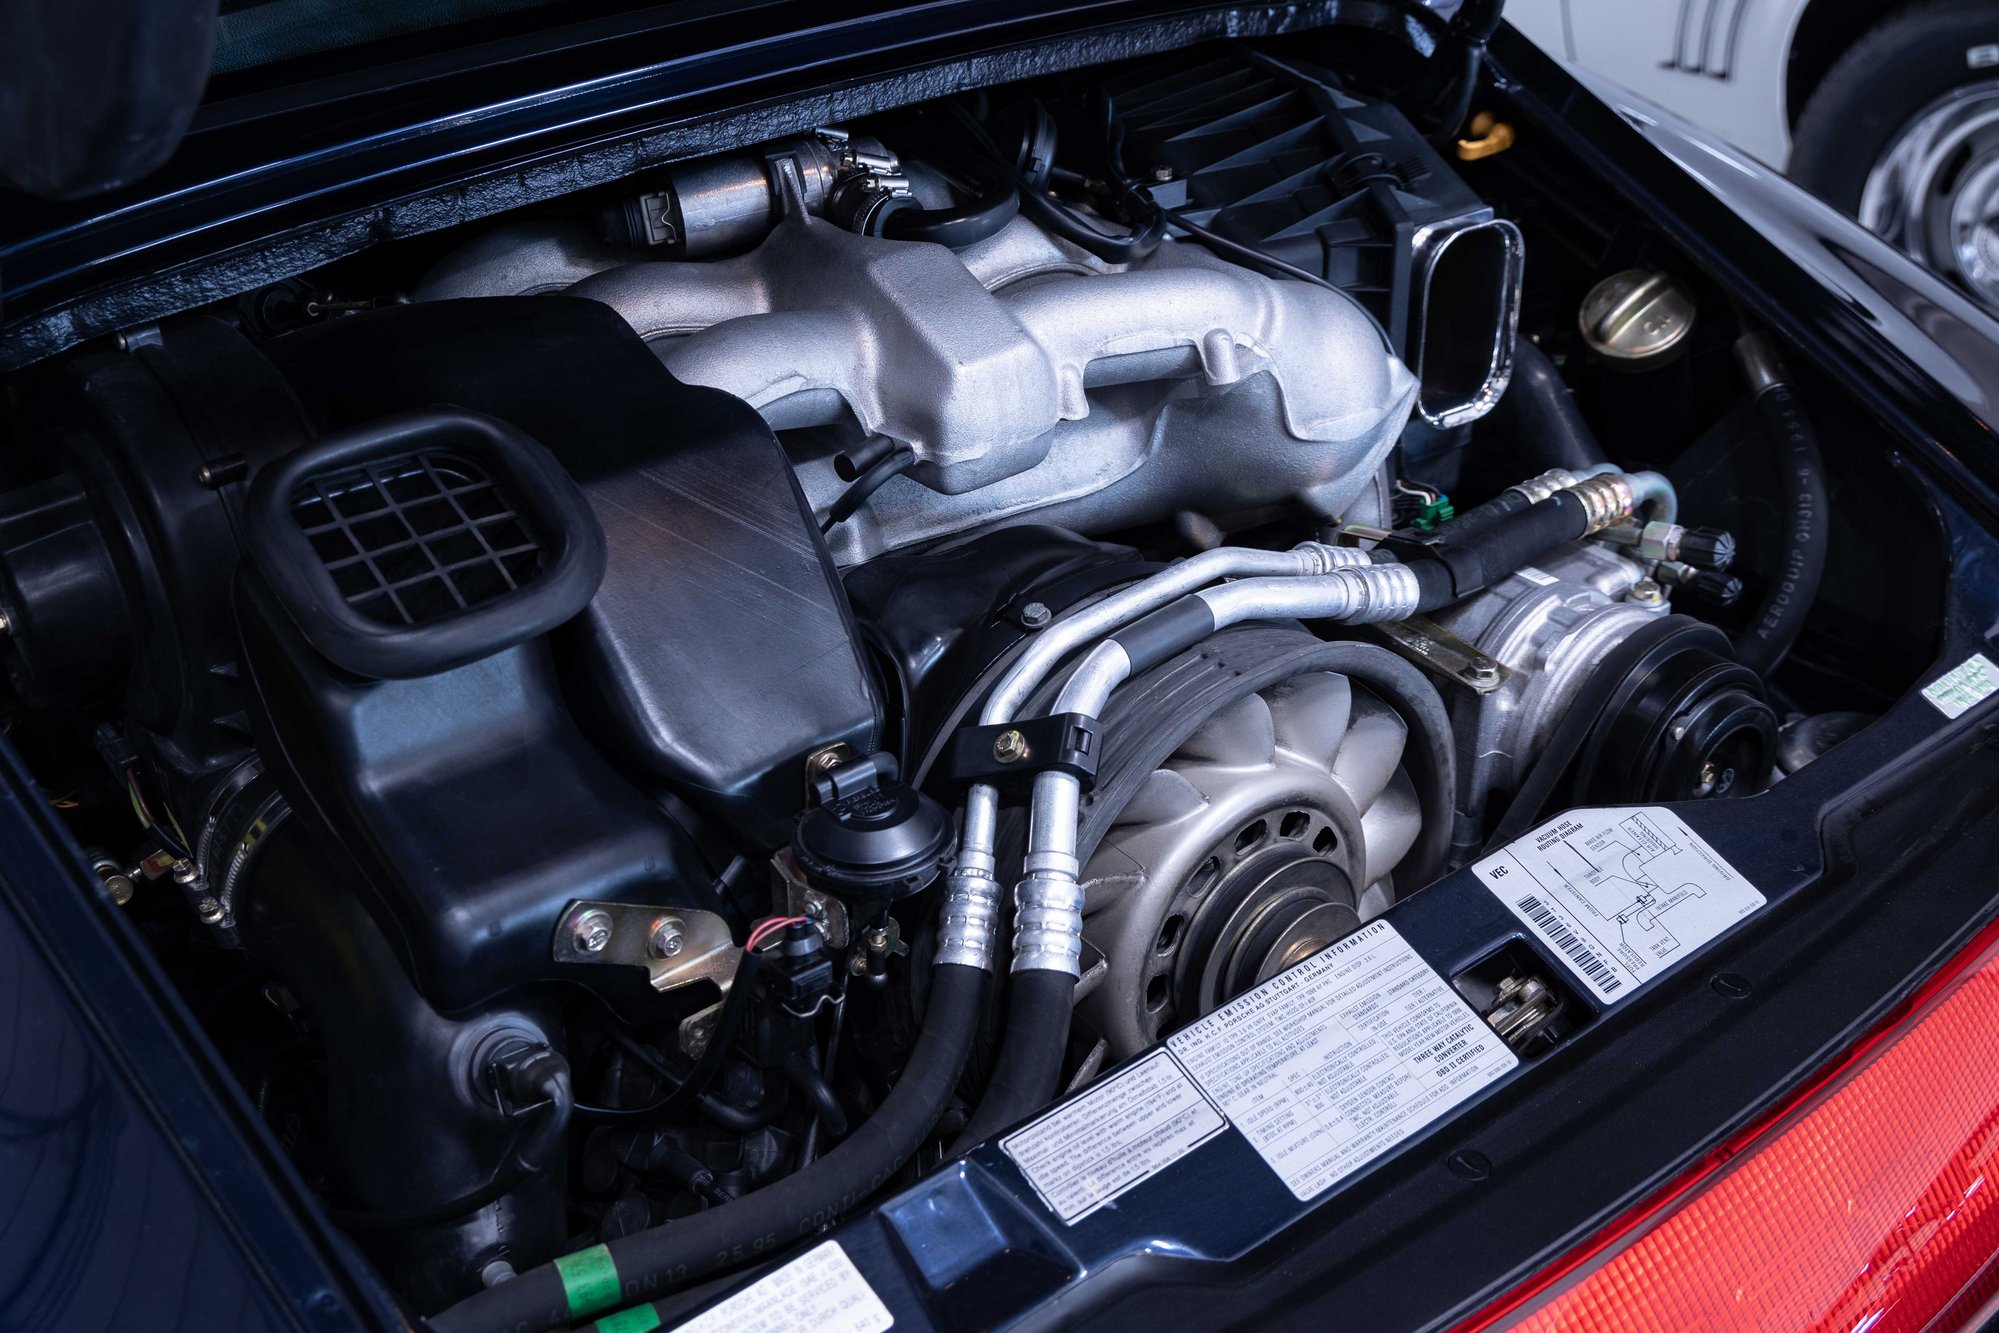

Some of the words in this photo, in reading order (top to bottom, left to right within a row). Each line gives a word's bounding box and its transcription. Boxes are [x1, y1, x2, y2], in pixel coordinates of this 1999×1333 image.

[1535, 827, 1558, 843] VACUUM
[1556, 820, 1572, 831] HOSE
[1536, 835, 1561, 852] ROUTING
[1558, 822, 1583, 839] DIAGRAM
[1488, 865, 1509, 880] VEC
[1654, 900, 1670, 911] INTAKE
[1667, 889, 1688, 903] MANIFOLD
[1169, 1019, 1214, 1048] VEHICLE
[1217, 988, 1269, 1021] EMISSION
[1271, 961, 1317, 990] CONTROL
[1319, 923, 1385, 963] INFORMATION
[1281, 1014, 1308, 1032] WORKSHOP
[1306, 1003, 1327, 1017] MANUAL
[1325, 998, 1336, 1006] FOR
[1334, 985, 1357, 1001] DETAILED
[1355, 970, 1384, 989] ADJUSTMENT
[1382, 953, 1413, 973] INSTRUCTIONS
[1386, 979, 1410, 995] STANDARD
[1408, 967, 1430, 983] CATEGORY
[1411, 989, 1423, 998] TIER
[1176, 1044, 1190, 1054] DR.
[1223, 1007, 1255, 1028] PORSCHE
[1254, 1002, 1265, 1011] AG
[1264, 982, 1300, 1005] STUTTGART
[1303, 962, 1335, 983] GERMANY
[1338, 1004, 1360, 1019] EXHAUST
[1357, 992, 1381, 1008] EMISSION
[1352, 1002, 1379, 1020] STANDARDS
[1404, 1002, 1416, 1011] TIER
[1416, 985, 1444, 1004] ALTERNATIVE
[1357, 1009, 1390, 1030] CERTIFICATION
[1381, 1030, 1393, 1040] THIS
[1391, 1019, 1411, 1033] VEHICLE
[1409, 1005, 1434, 1022] CONFORMS
[1396, 1031, 1407, 1040] EPA
[1404, 1025, 1416, 1035] AND
[1414, 1018, 1428, 1029] STATE
[1432, 1000, 1458, 1018] CALIFORNIA
[1233, 1030, 1257, 1046] CONTROL
[1392, 1030, 1423, 1051] REGULATIONS
[1420, 1016, 1447, 1034] APPLICABLE
[1398, 1044, 1416, 1057] MODEL
[1413, 1038, 1426, 1048] YEAR
[1424, 1032, 1436, 1041] NEW
[1433, 1023, 1451, 1035] MOTOR
[1448, 1011, 1469, 1026] VEHICLES
[1412, 1048, 1434, 1064] THREE
[1431, 1040, 1447, 1052] WAY
[1444, 1023, 1475, 1044] CATALYTIC
[1239, 1047, 1268, 1066] APPLICABLE
[1272, 1038, 1282, 1047] ALL
[1248, 1048, 1286, 1072] SPECIFICATIONS
[1283, 1042, 1296, 1052] AND
[1294, 1023, 1328, 1046] ADJUSTMENTS
[1321, 1040, 1353, 1061] INSTRUCTION
[1433, 1038, 1468, 1063] CONVERTER
[1435, 1065, 1450, 1077] OBD
[1448, 1061, 1457, 1069] II
[1454, 1043, 1485, 1065] CERTIFIED
[1240, 1068, 1268, 1087] OPERATING
[1298, 1044, 1307, 1052] AT
[1304, 1037, 1320, 1049] LEAST
[1311, 1054, 1349, 1080] ELECTRONICALLY
[1316, 1076, 1328, 1086] NOT
[1323, 1069, 1361, 1094] ELECTRONICALLY
[1356, 1084, 1377, 1099] SENSOR
[1374, 1072, 1396, 1088] CONTACT
[1372, 1082, 1395, 1099] MEASURE
[1393, 1072, 1412, 1086] BEFORE
[1329, 1091, 1341, 1101] NOT
[1319, 1151, 1341, 1168] MANUAL
[1339, 1145, 1352, 1155] AND
[1405, 1095, 1430, 1113] SCHEDULE
[1428, 1089, 1439, 1098] FOR
[1448, 1064, 1479, 1086] INFORMATION
[1361, 1106, 1373, 1116] NOT
[1352, 1139, 1386, 1164] ADJUSTMENTS
